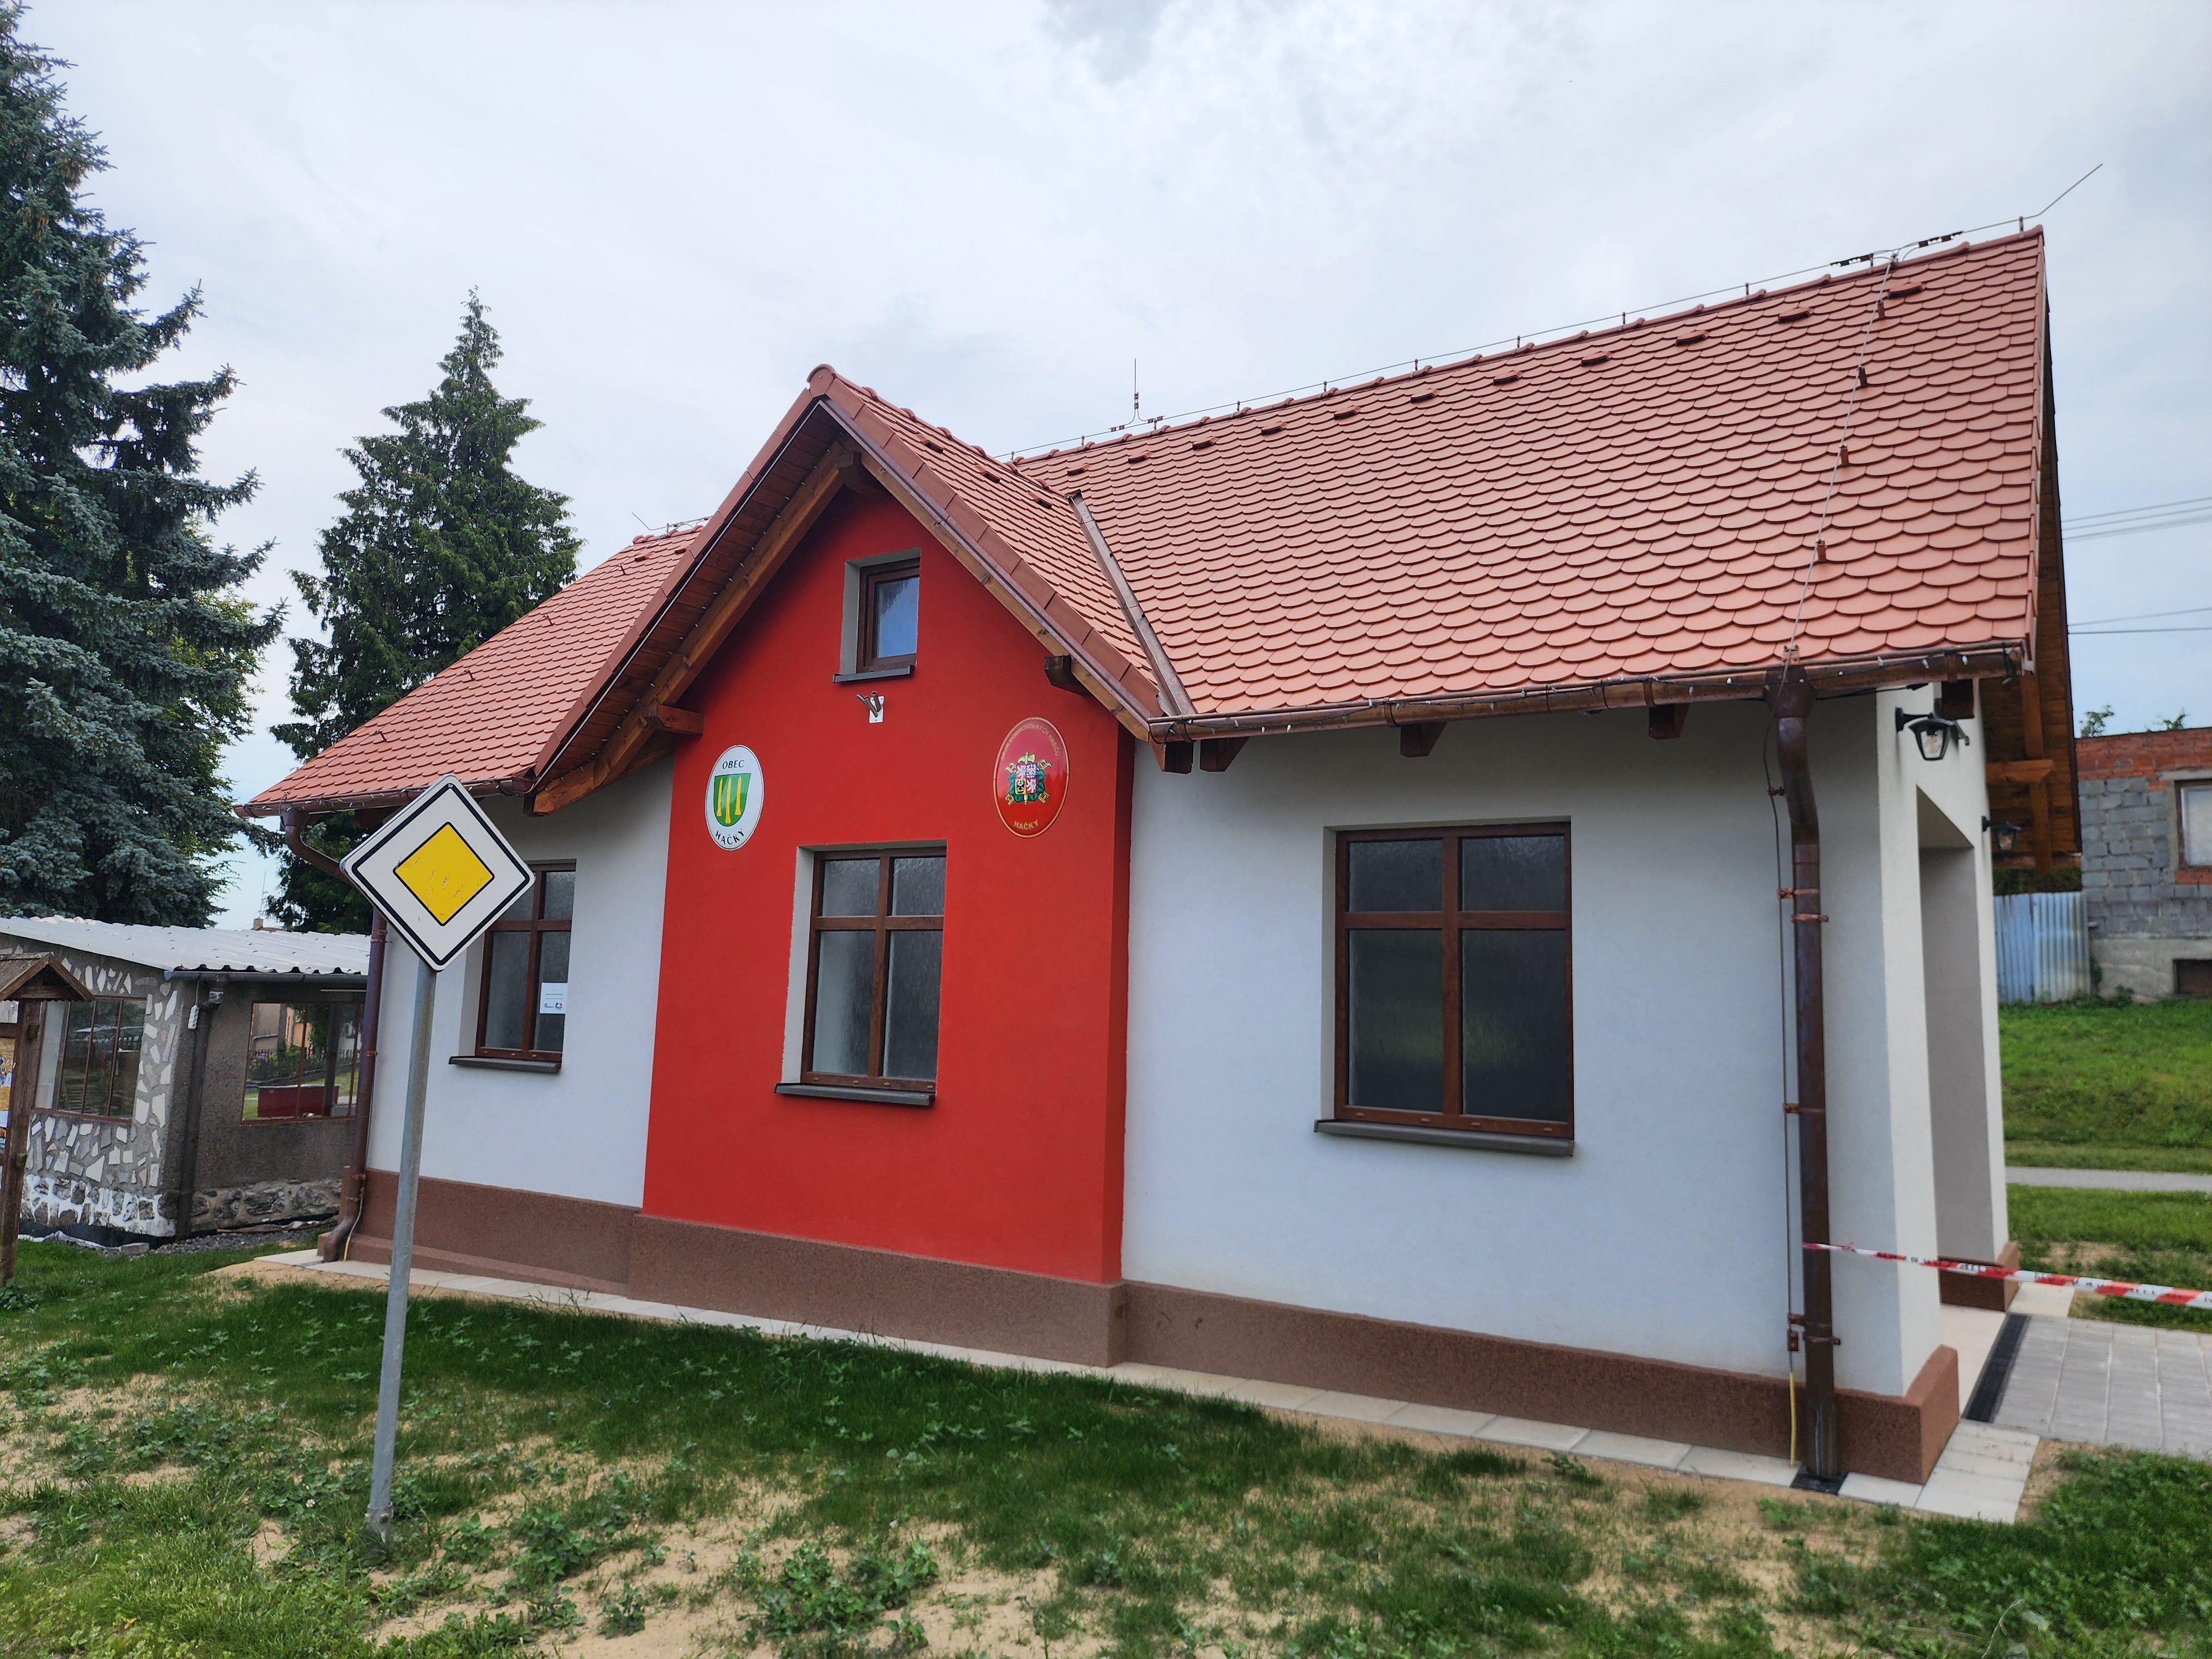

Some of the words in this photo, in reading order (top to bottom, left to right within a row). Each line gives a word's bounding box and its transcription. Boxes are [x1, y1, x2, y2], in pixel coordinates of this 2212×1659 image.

[722, 759, 745, 769] OBEC
[1014, 819, 1039, 831] HAČKY
[715, 828, 744, 845] HAČKY
